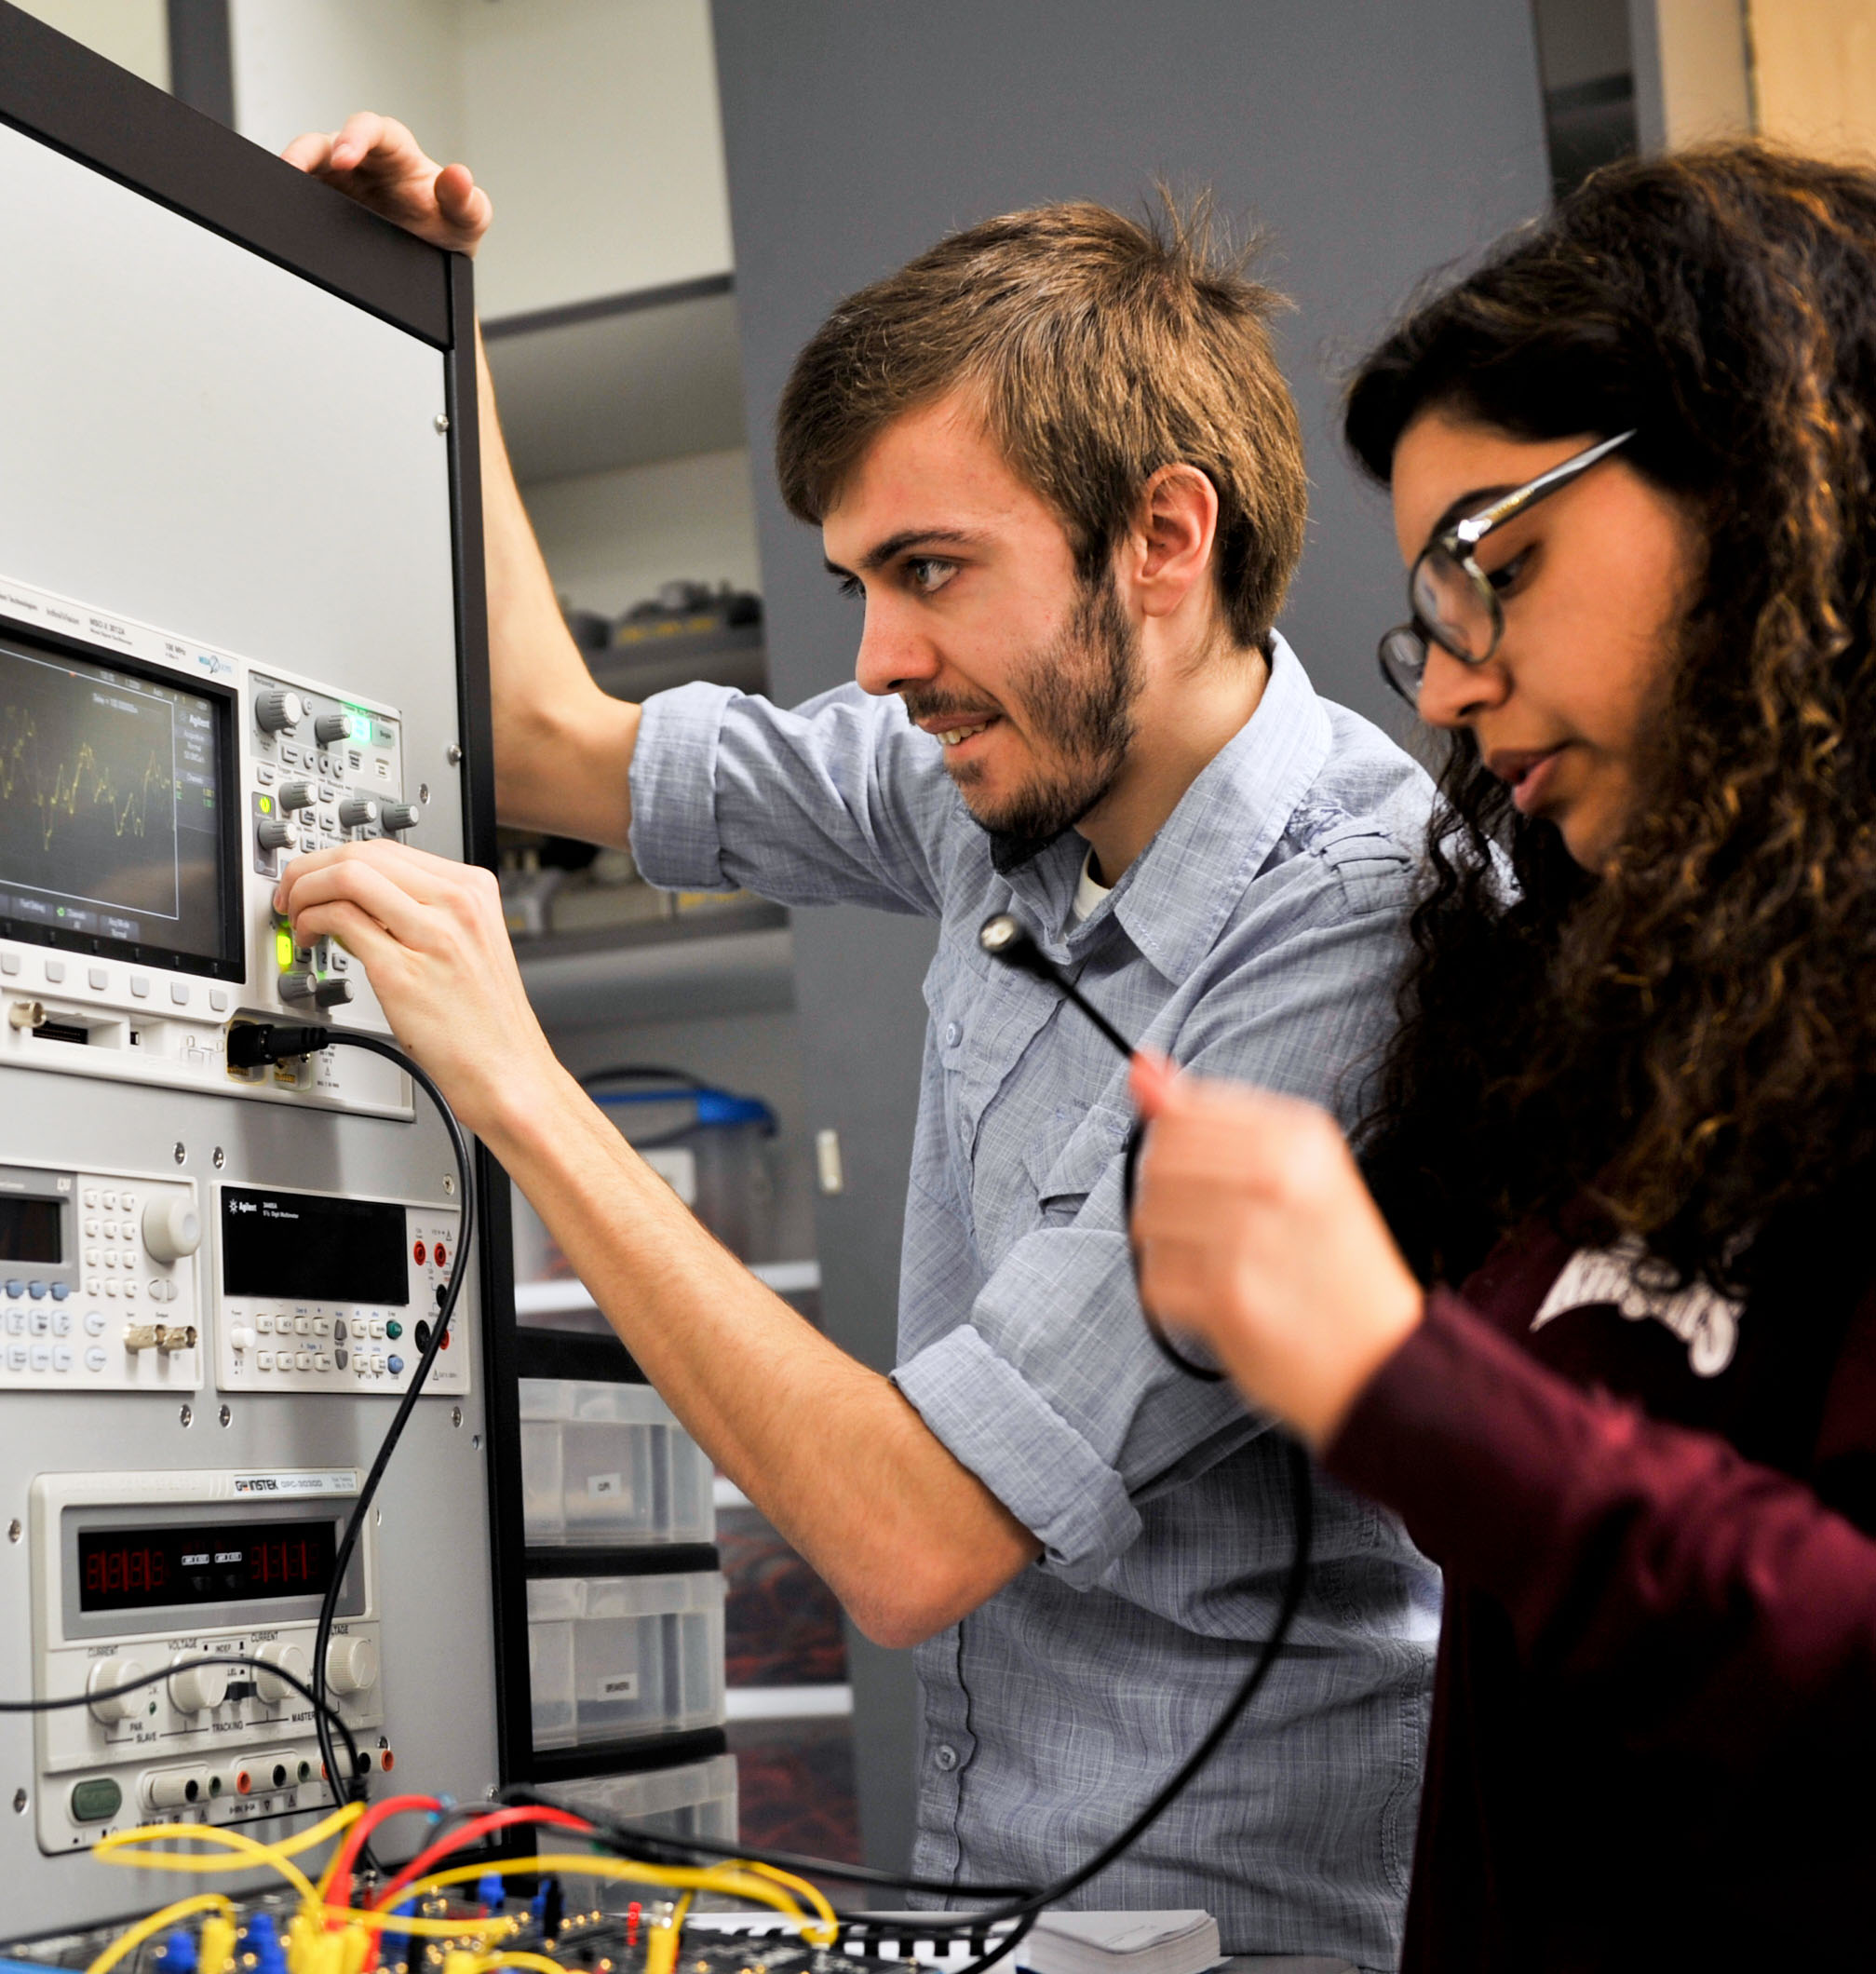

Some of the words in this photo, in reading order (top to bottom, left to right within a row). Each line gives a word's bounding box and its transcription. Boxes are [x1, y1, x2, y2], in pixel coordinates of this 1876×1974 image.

[238, 1201, 257, 1214] Agilent
[250, 1630, 279, 1643] CURRENT
[87, 1643, 119, 1657] CURRENT
[169, 1638, 198, 1651] VOLTAGE
[212, 1720, 244, 1734] TRACKING
